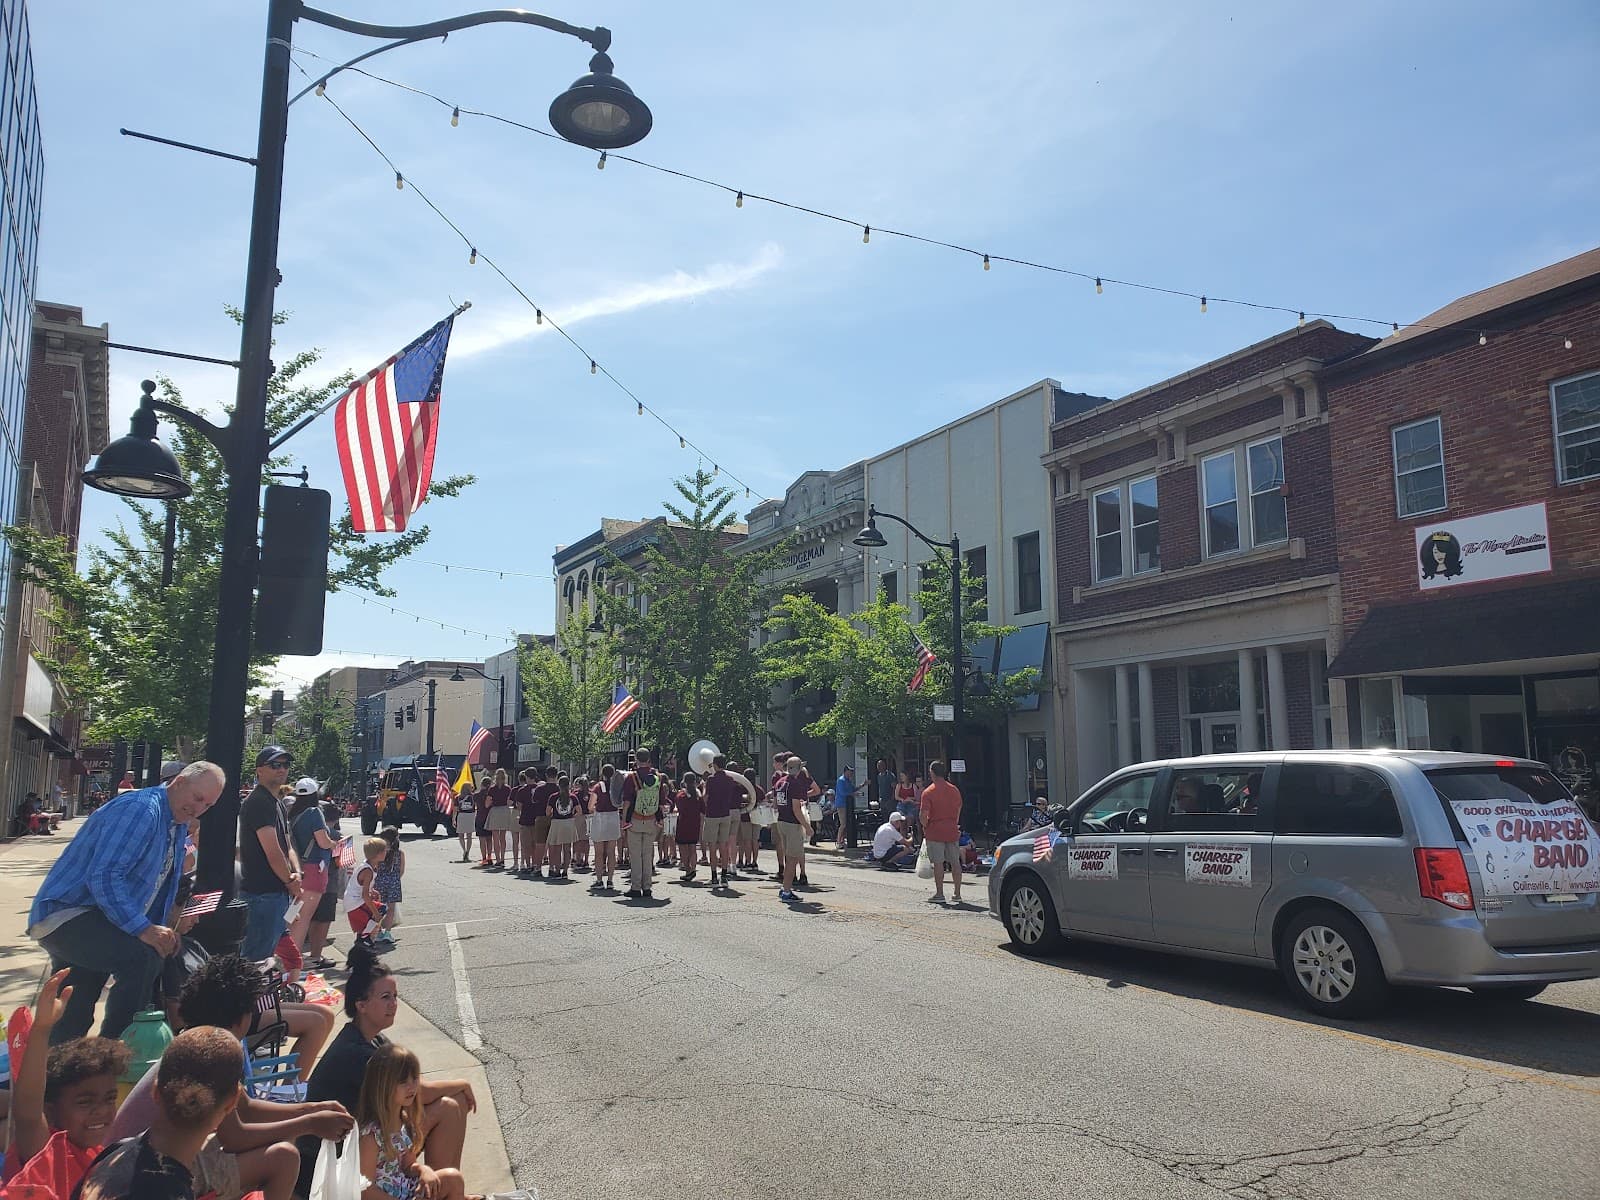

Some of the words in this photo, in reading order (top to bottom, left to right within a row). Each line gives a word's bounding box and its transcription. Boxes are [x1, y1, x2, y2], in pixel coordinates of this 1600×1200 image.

[1463, 807, 1492, 816] GOOD
[1073, 850, 1111, 861] CHARGER
[1192, 850, 1243, 864] CHARGER
[1533, 844, 1589, 868] BAND
[1081, 860, 1104, 871] BAND
[1202, 863, 1233, 875] BAND
